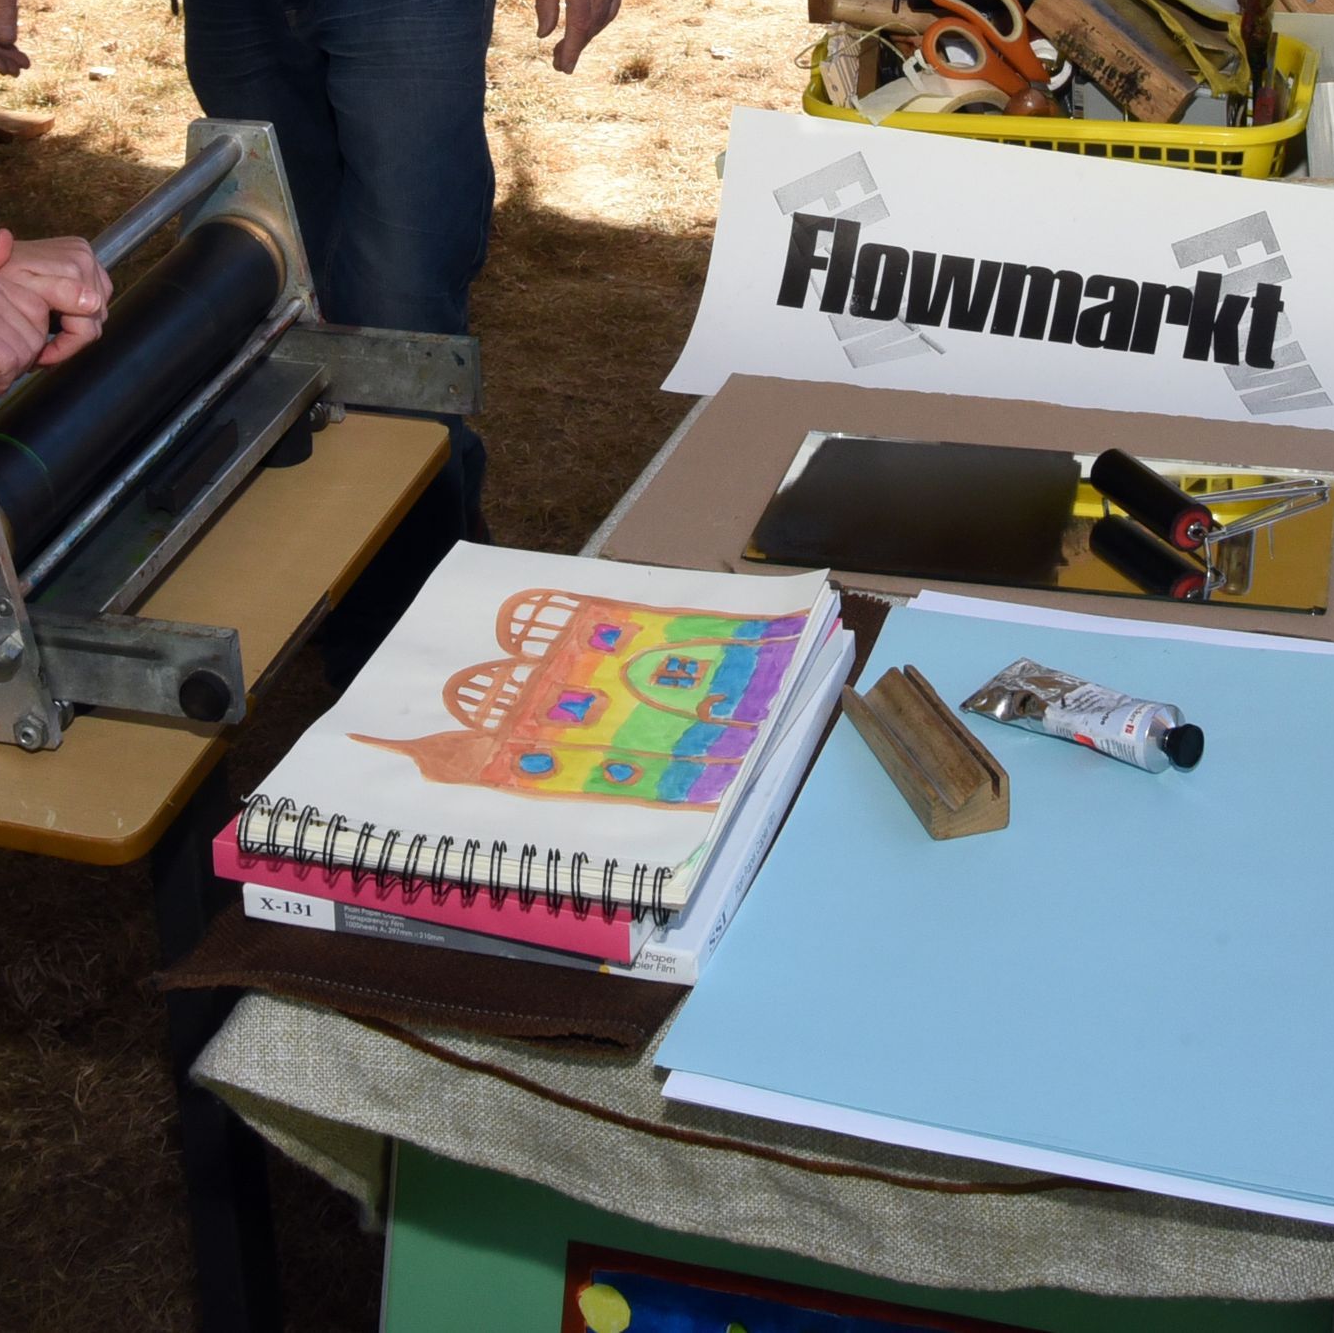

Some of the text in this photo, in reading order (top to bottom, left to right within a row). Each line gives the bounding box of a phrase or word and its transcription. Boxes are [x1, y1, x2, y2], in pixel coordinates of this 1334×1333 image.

[777, 212, 1284, 369] Flowmarkt
[260, 897, 312, 917] X-131
[645, 952, 677, 966] Paper
[656, 963, 676, 974] Film
